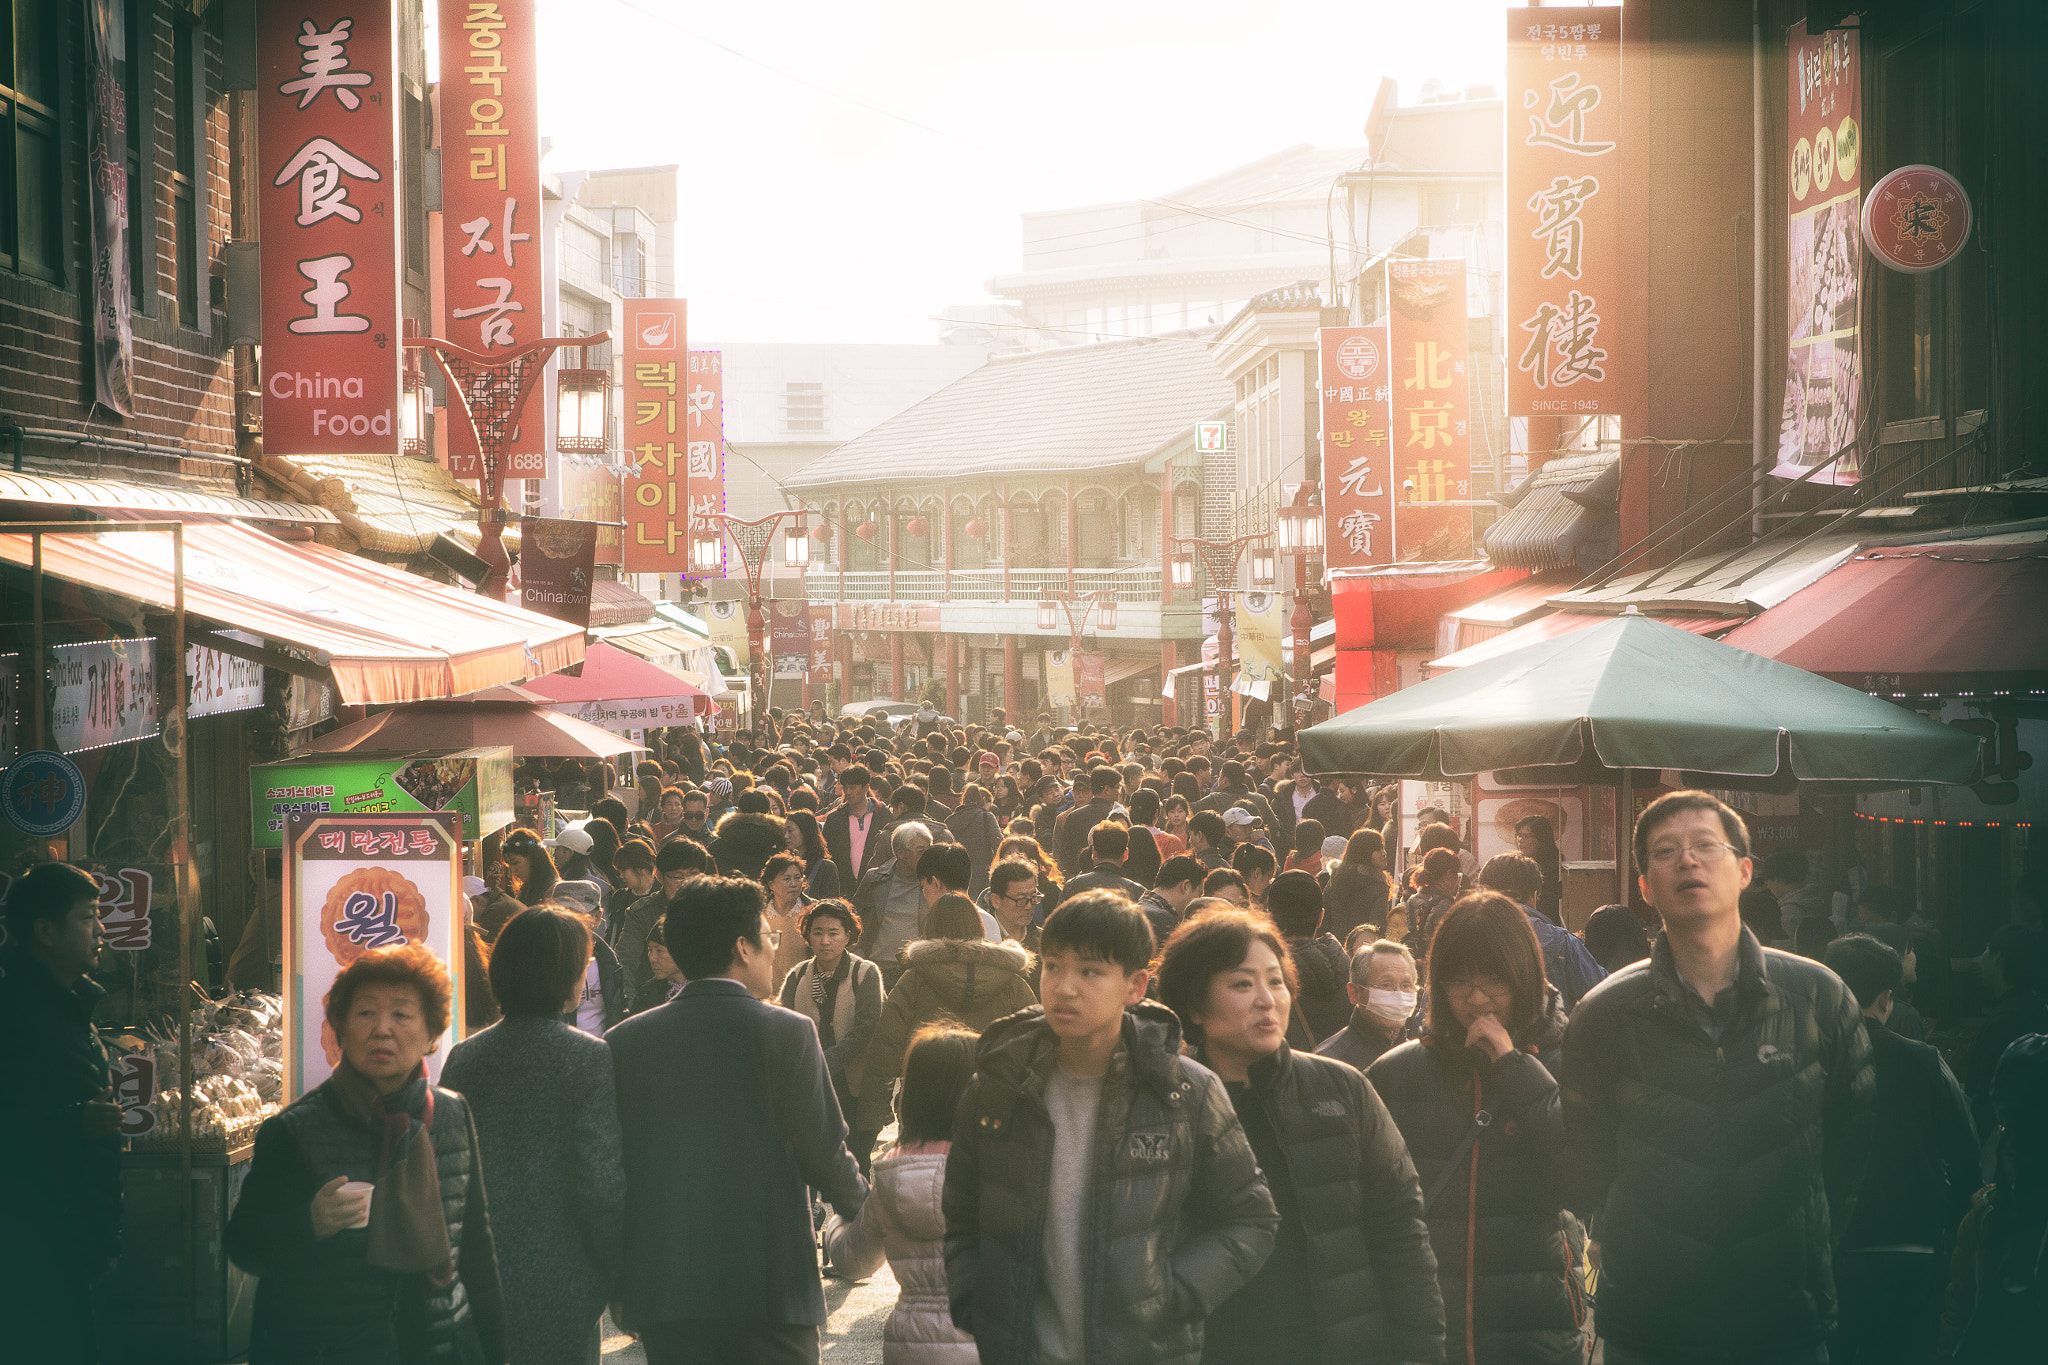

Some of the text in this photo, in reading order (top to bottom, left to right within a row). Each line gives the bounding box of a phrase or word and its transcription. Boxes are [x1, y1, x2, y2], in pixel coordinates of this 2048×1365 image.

[1527, 23, 1602, 41] 전국5짬뽕
[1541, 43, 1588, 61] 영빈루
[463, 1, 511, 191] 중국요리
[273, 16, 383, 335] 美食王
[1902, 201, 1939, 238] 宋
[1893, 241, 1948, 261] 전문점
[267, 370, 364, 400] China
[1324, 385, 1390, 404] 中國正統
[1531, 399, 1599, 411] SINCE 1945
[311, 409, 392, 437] Food
[1346, 408, 1371, 428] 왕
[635, 361, 684, 556] 럭키차이나
[525, 588, 588, 605] Chinatown
[773, 631, 809, 639] Chinatown
[583, 709, 617, 722] 청정지역
[619, 708, 647, 720] 무공해
[17, 771, 67, 816] 神
[266, 785, 335, 799] 소고기스테이크
[272, 801, 331, 815] 새우스테이크
[318, 830, 438, 855] 대만전통
[333, 891, 408, 950] 월
